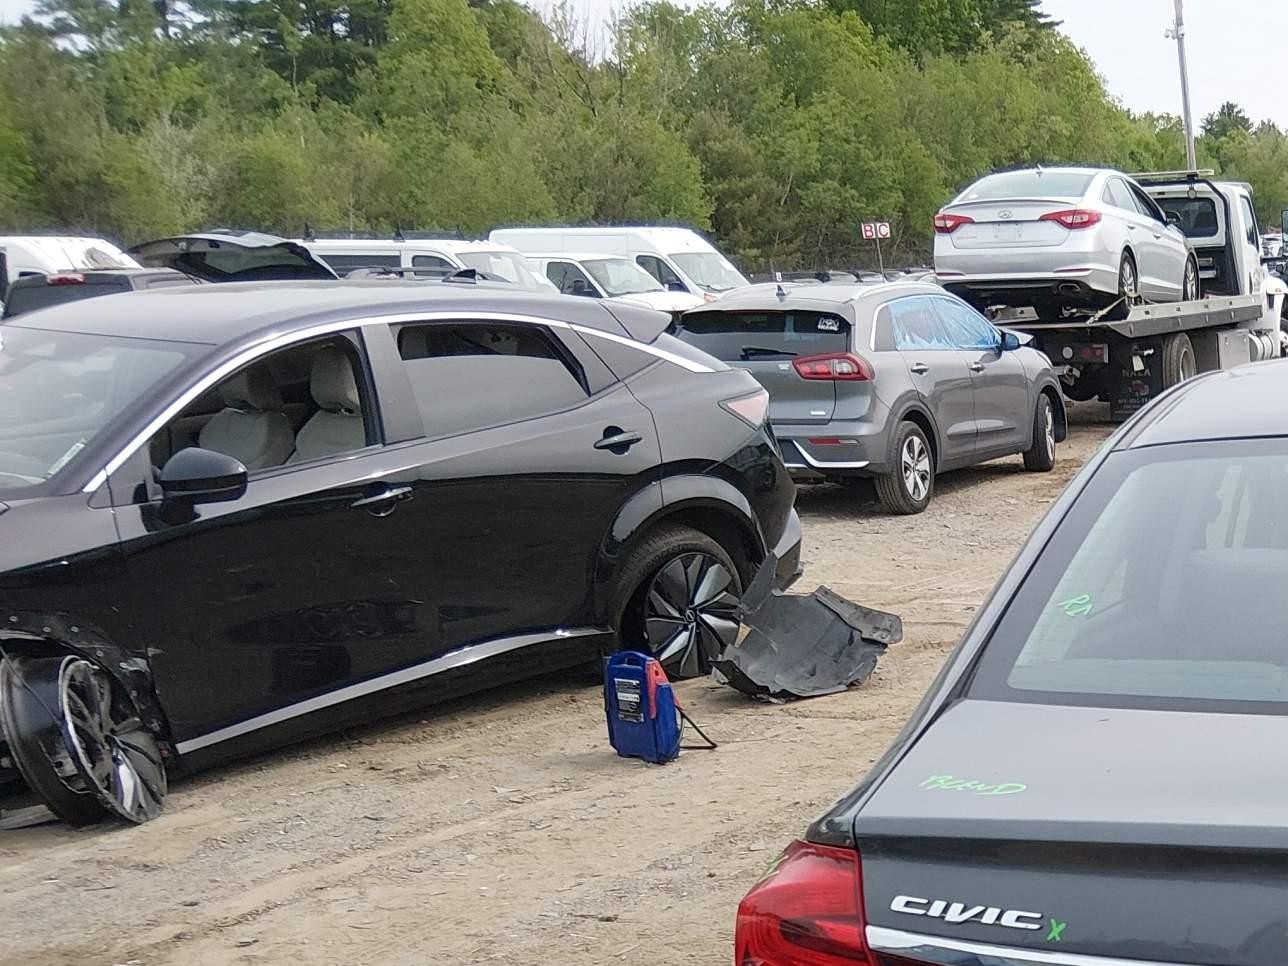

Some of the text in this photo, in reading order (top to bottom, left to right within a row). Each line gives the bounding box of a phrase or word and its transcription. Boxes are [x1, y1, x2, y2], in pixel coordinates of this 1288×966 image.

[864, 223, 889, 238] B C
[890, 895, 1043, 930] CIVIC
